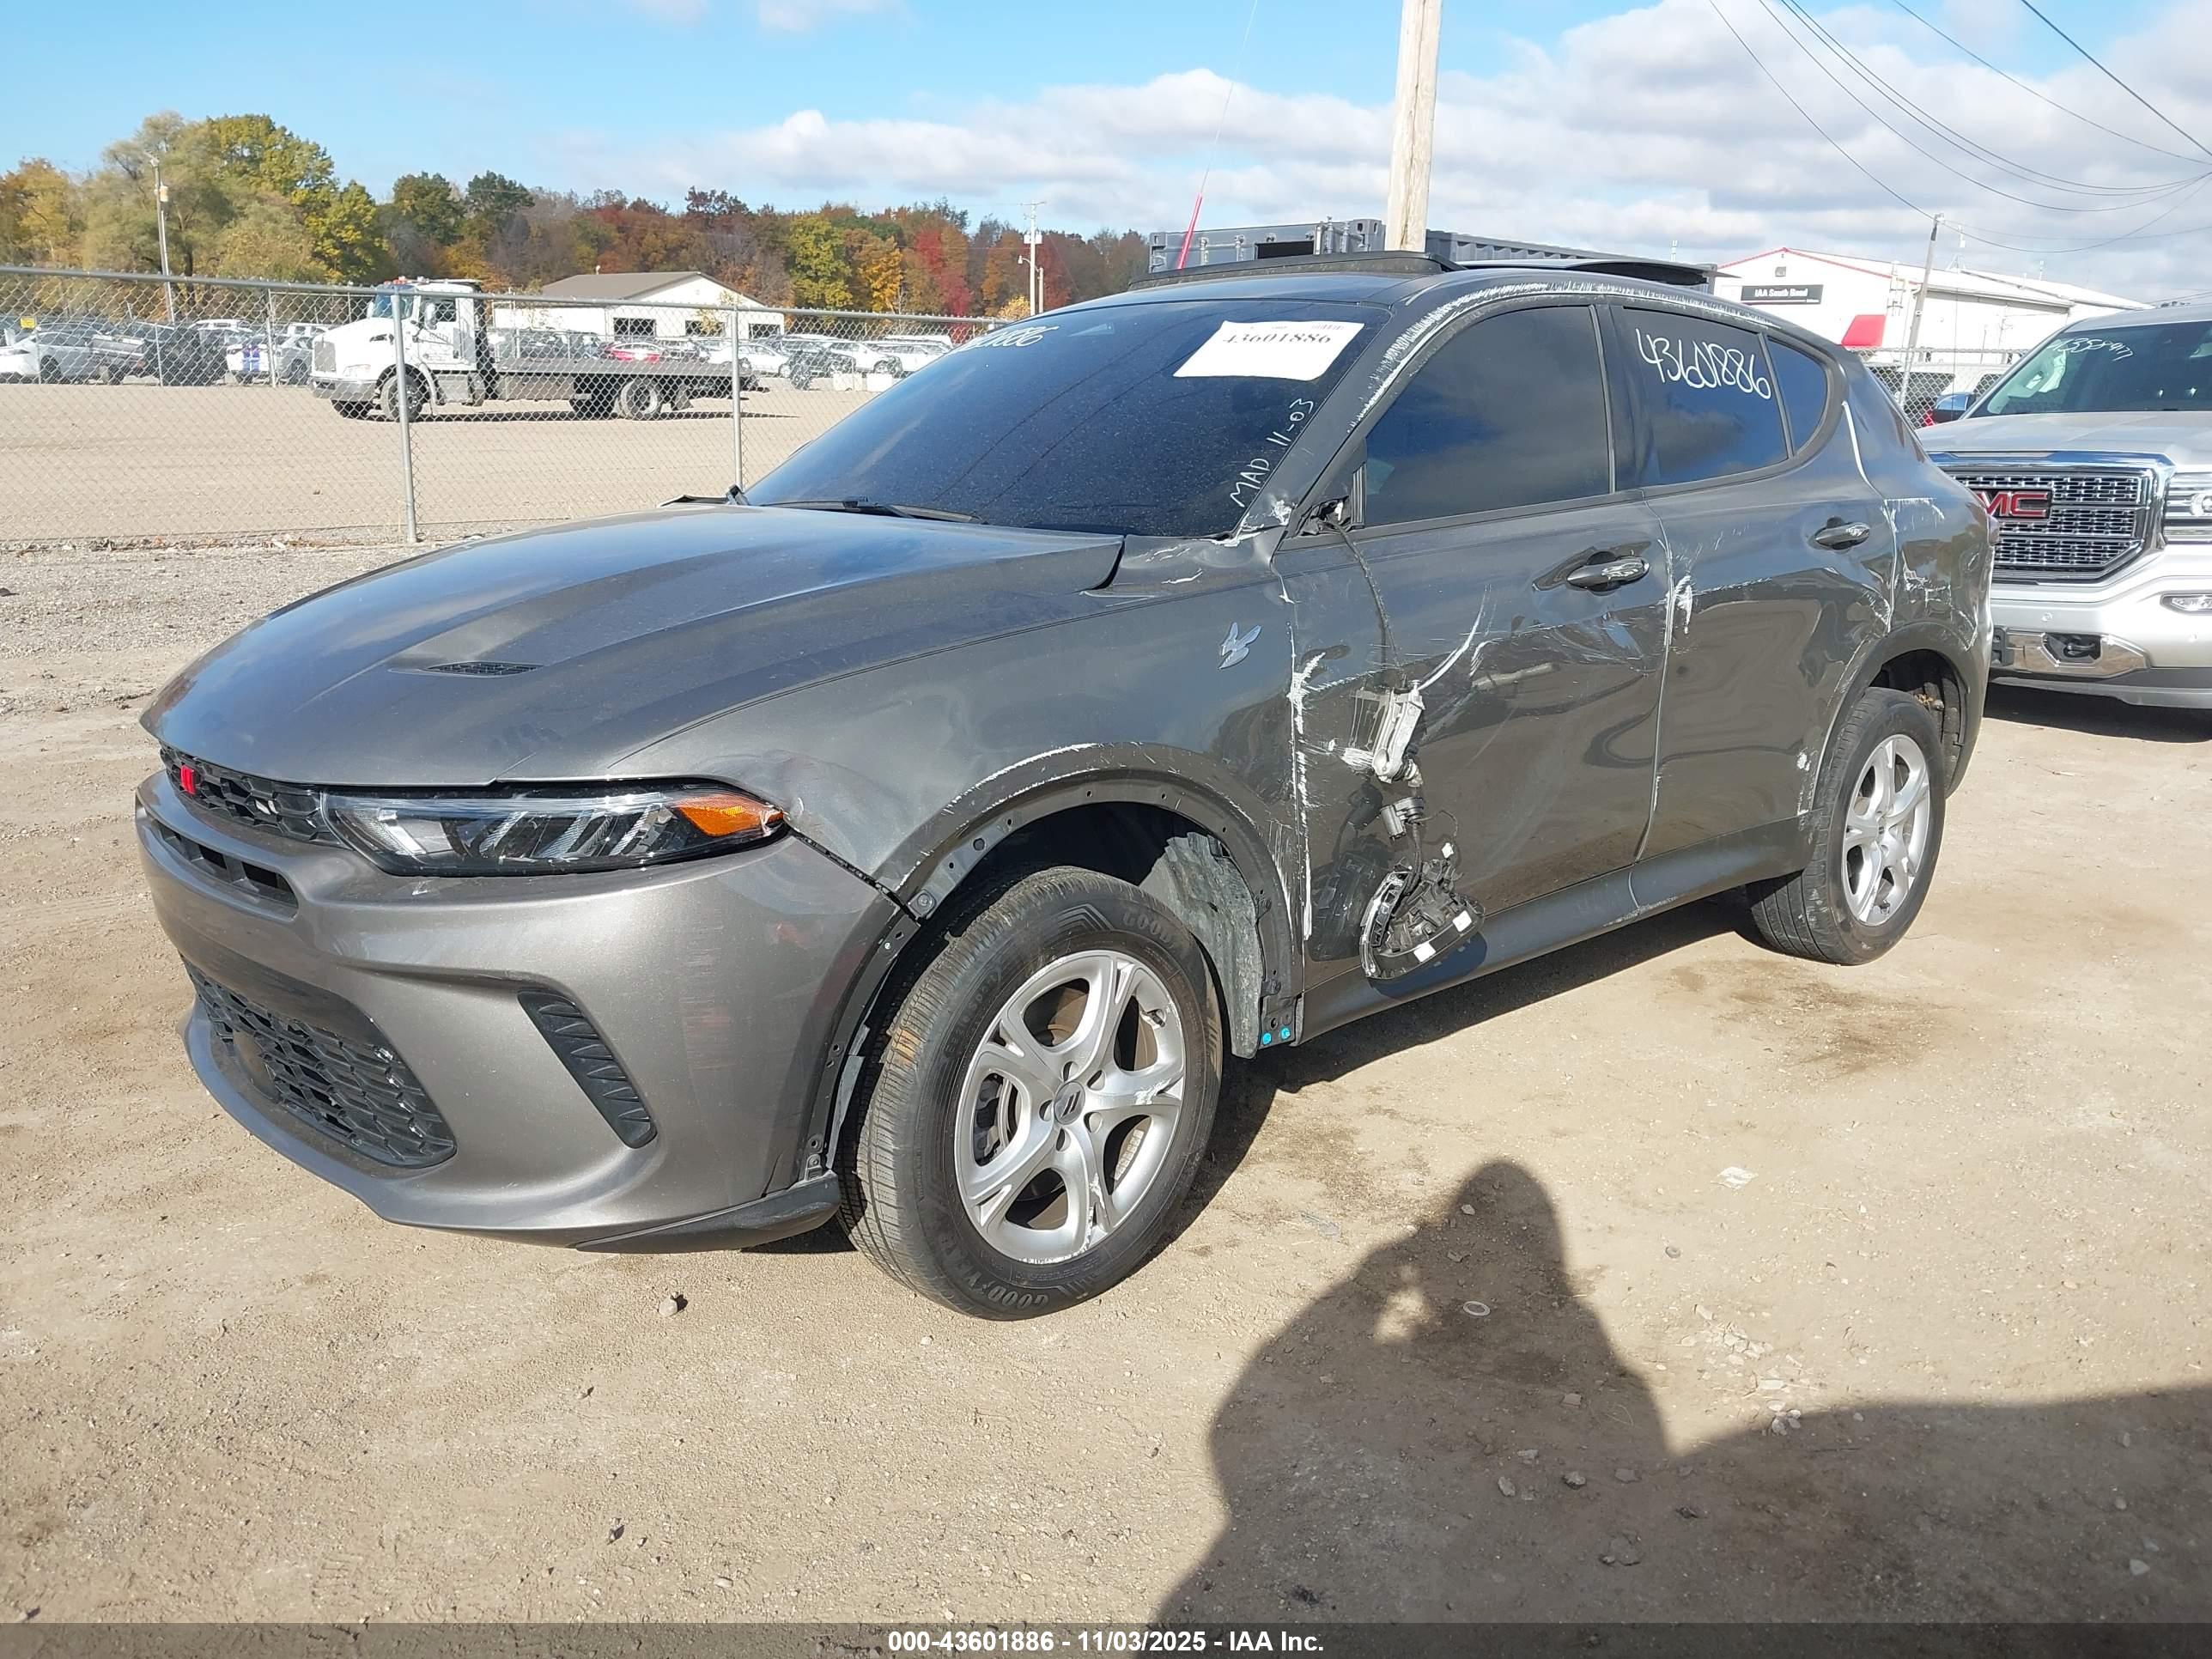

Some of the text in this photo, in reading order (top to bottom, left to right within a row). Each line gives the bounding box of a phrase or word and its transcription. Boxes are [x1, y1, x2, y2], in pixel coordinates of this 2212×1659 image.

[1754, 288, 1808, 297] IAA South Bend
[1223, 332, 1332, 343] 43601886
[1635, 328, 1771, 399] 43601886
[1230, 458, 1270, 508] MAD
[1975, 489, 2049, 517] MC
